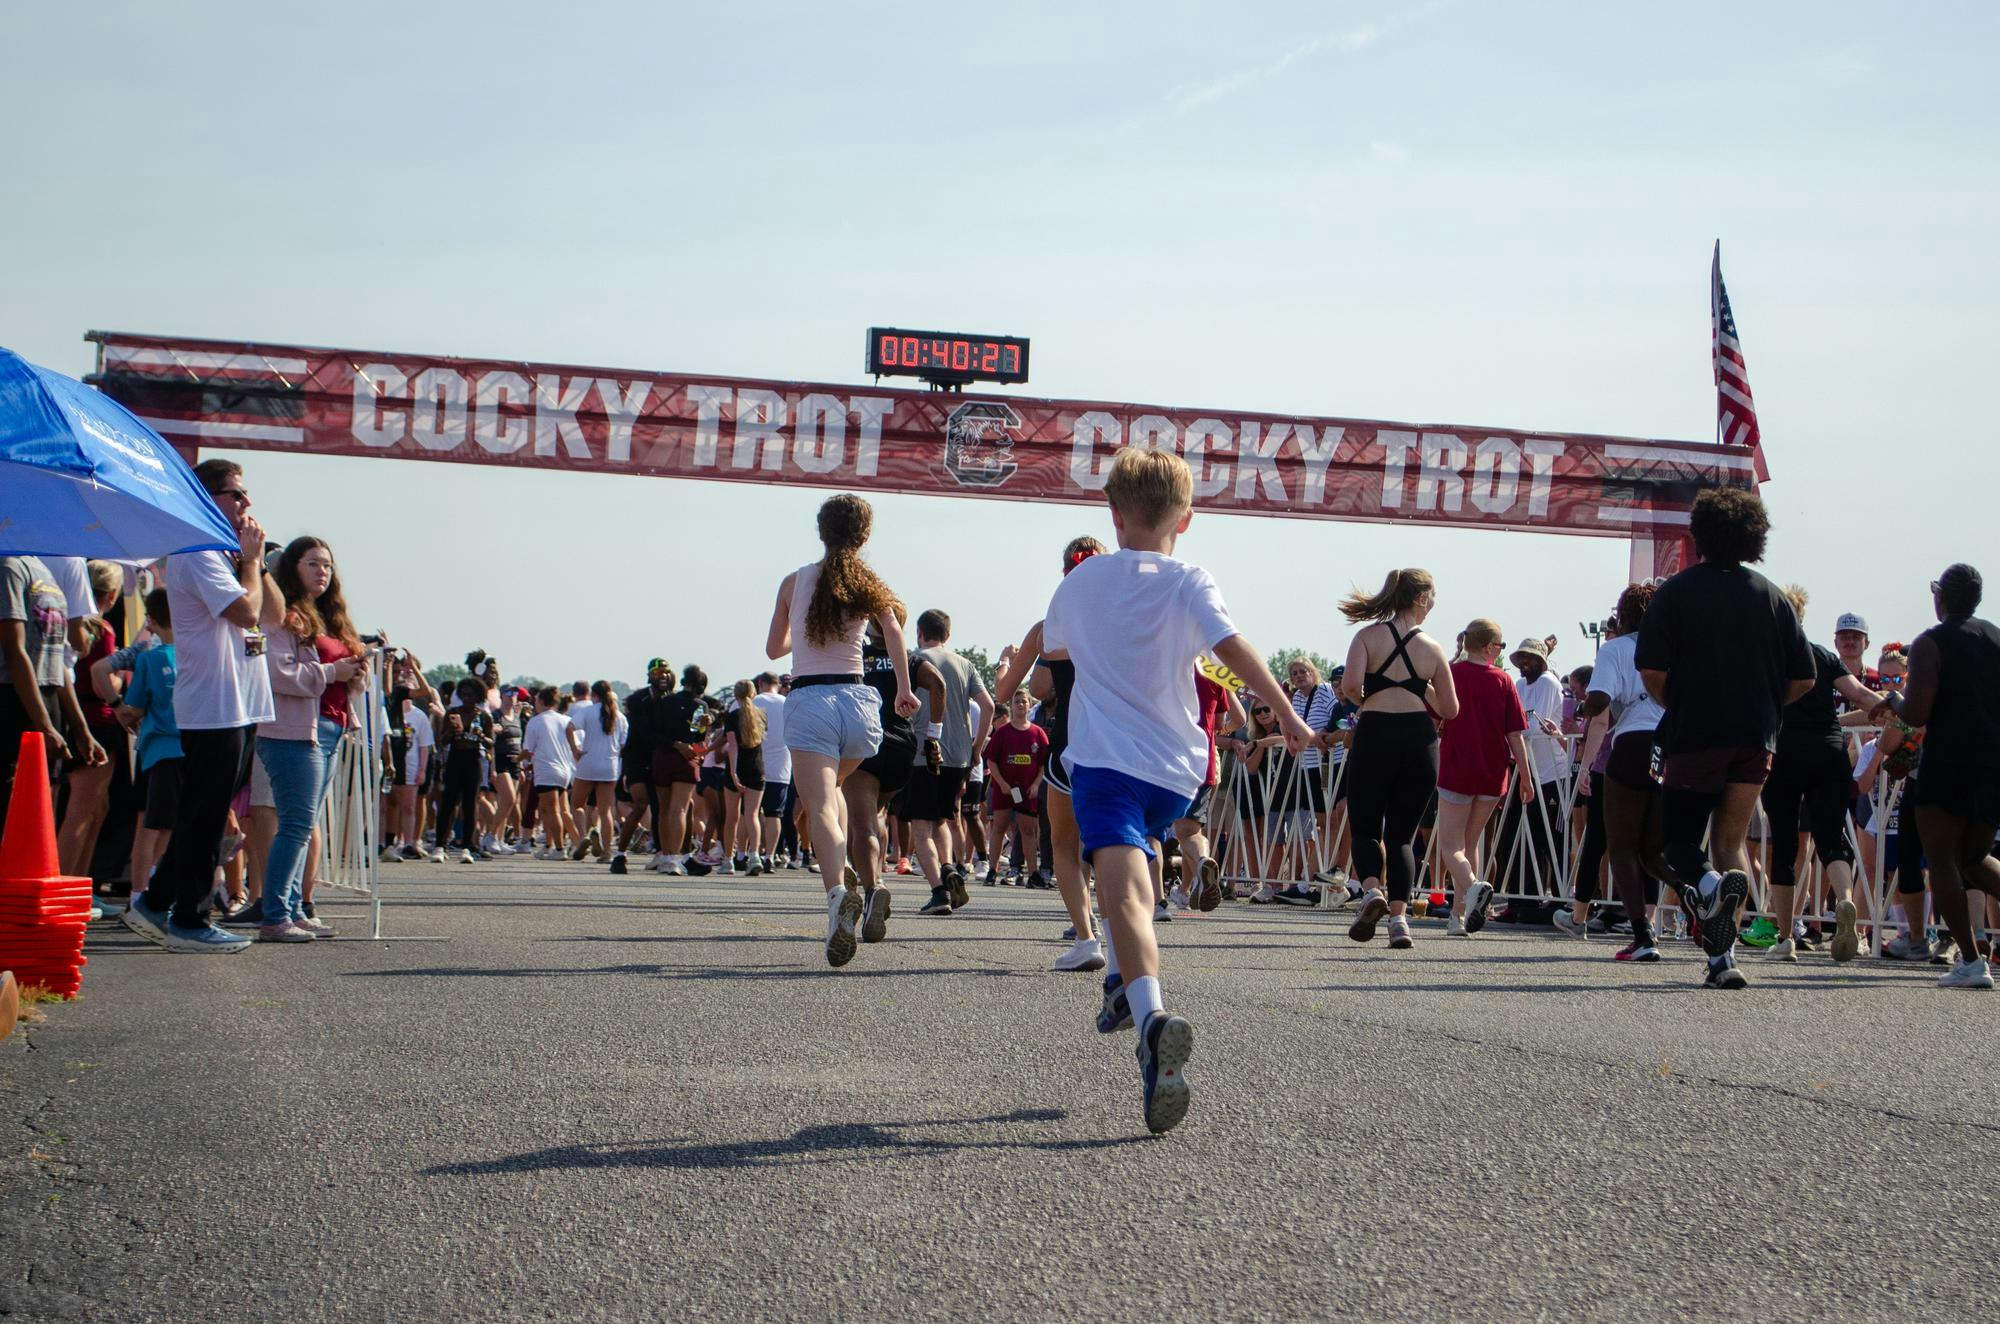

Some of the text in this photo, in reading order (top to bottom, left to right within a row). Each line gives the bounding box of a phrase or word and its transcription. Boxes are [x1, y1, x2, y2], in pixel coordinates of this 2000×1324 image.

[881, 336, 1020, 374] 00:40:27
[350, 363, 896, 477] COCKY TROT
[1376, 428, 1566, 516] TROT
